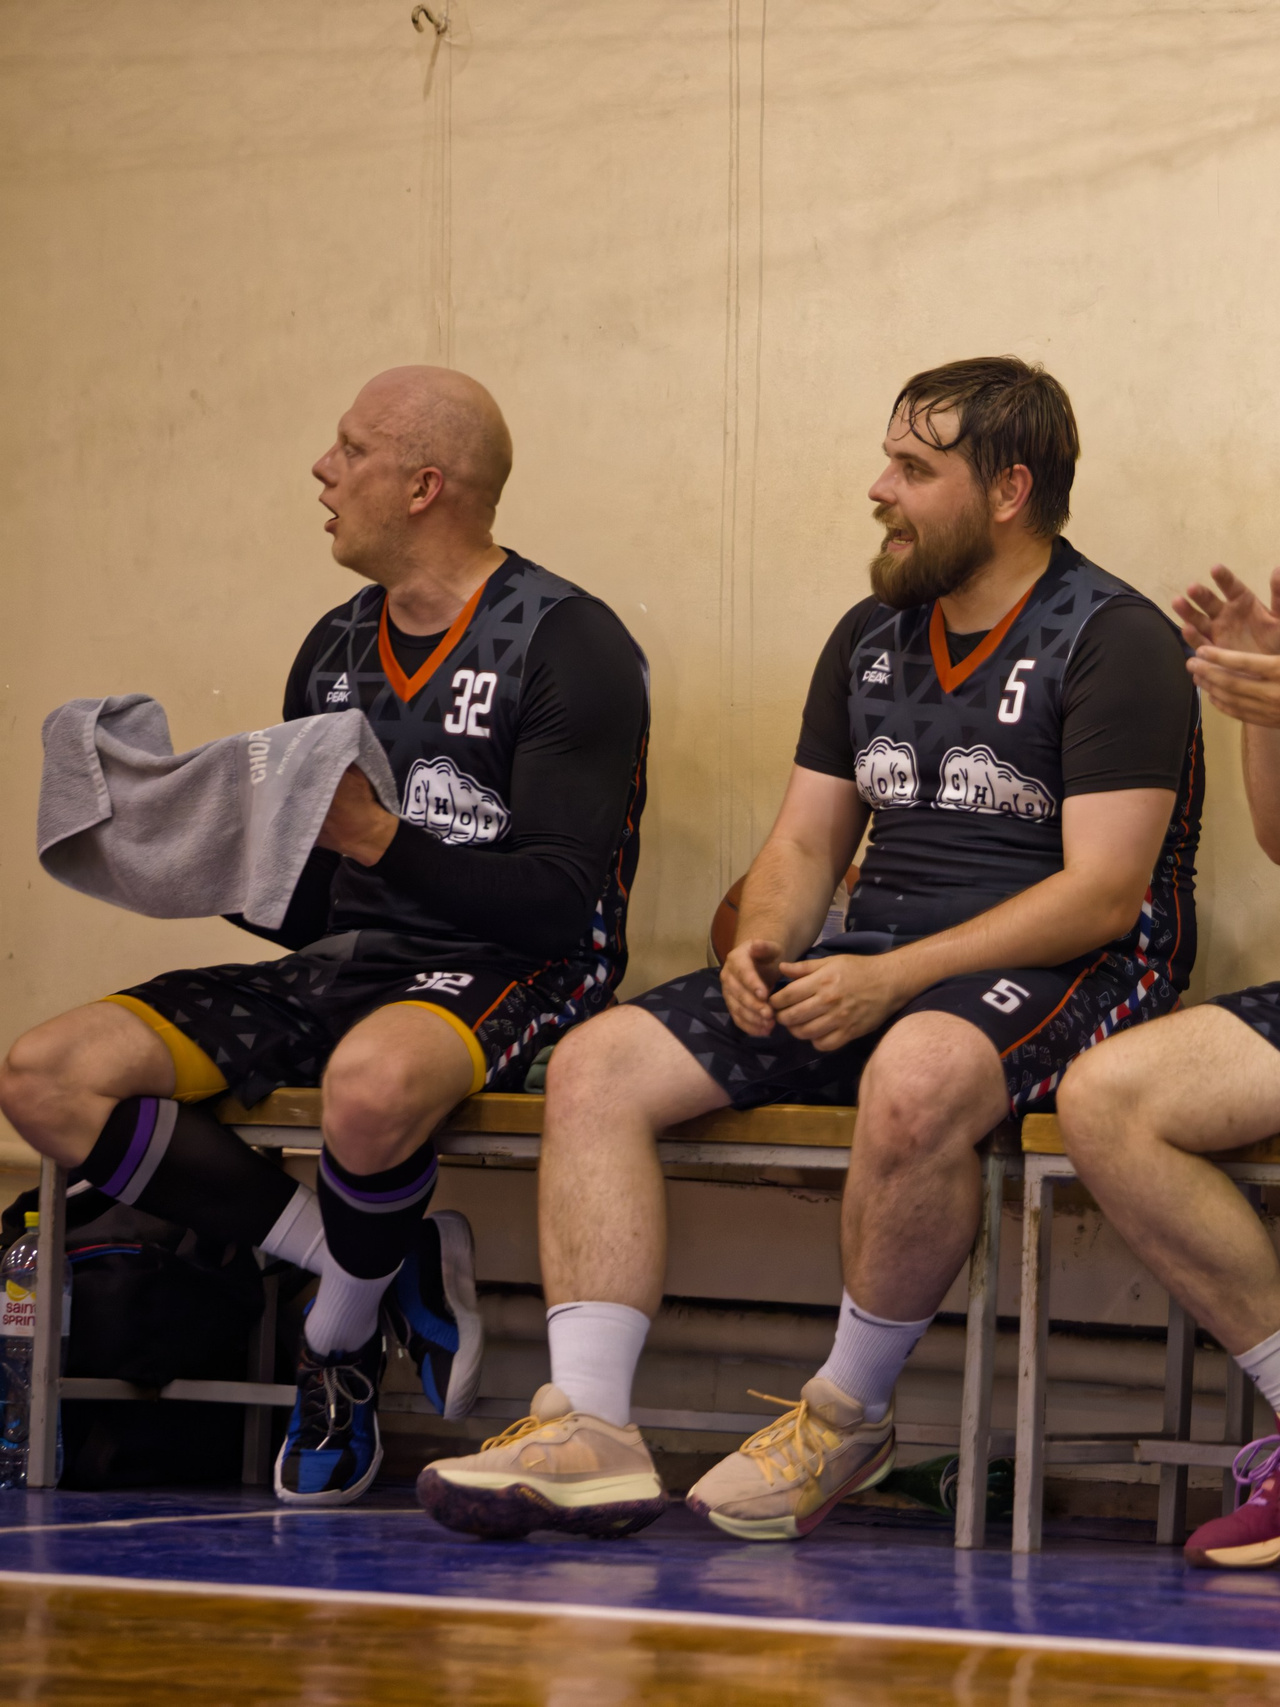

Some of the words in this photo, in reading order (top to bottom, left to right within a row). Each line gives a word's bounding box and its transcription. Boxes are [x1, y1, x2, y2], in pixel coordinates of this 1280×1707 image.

[326, 691, 352, 703] PEAK
[862, 670, 892, 685] PEAK
[997, 659, 1036, 723] 5
[444, 669, 497, 738] 32
[248, 730, 272, 784] CHOP
[981, 977, 1030, 1014] 5
